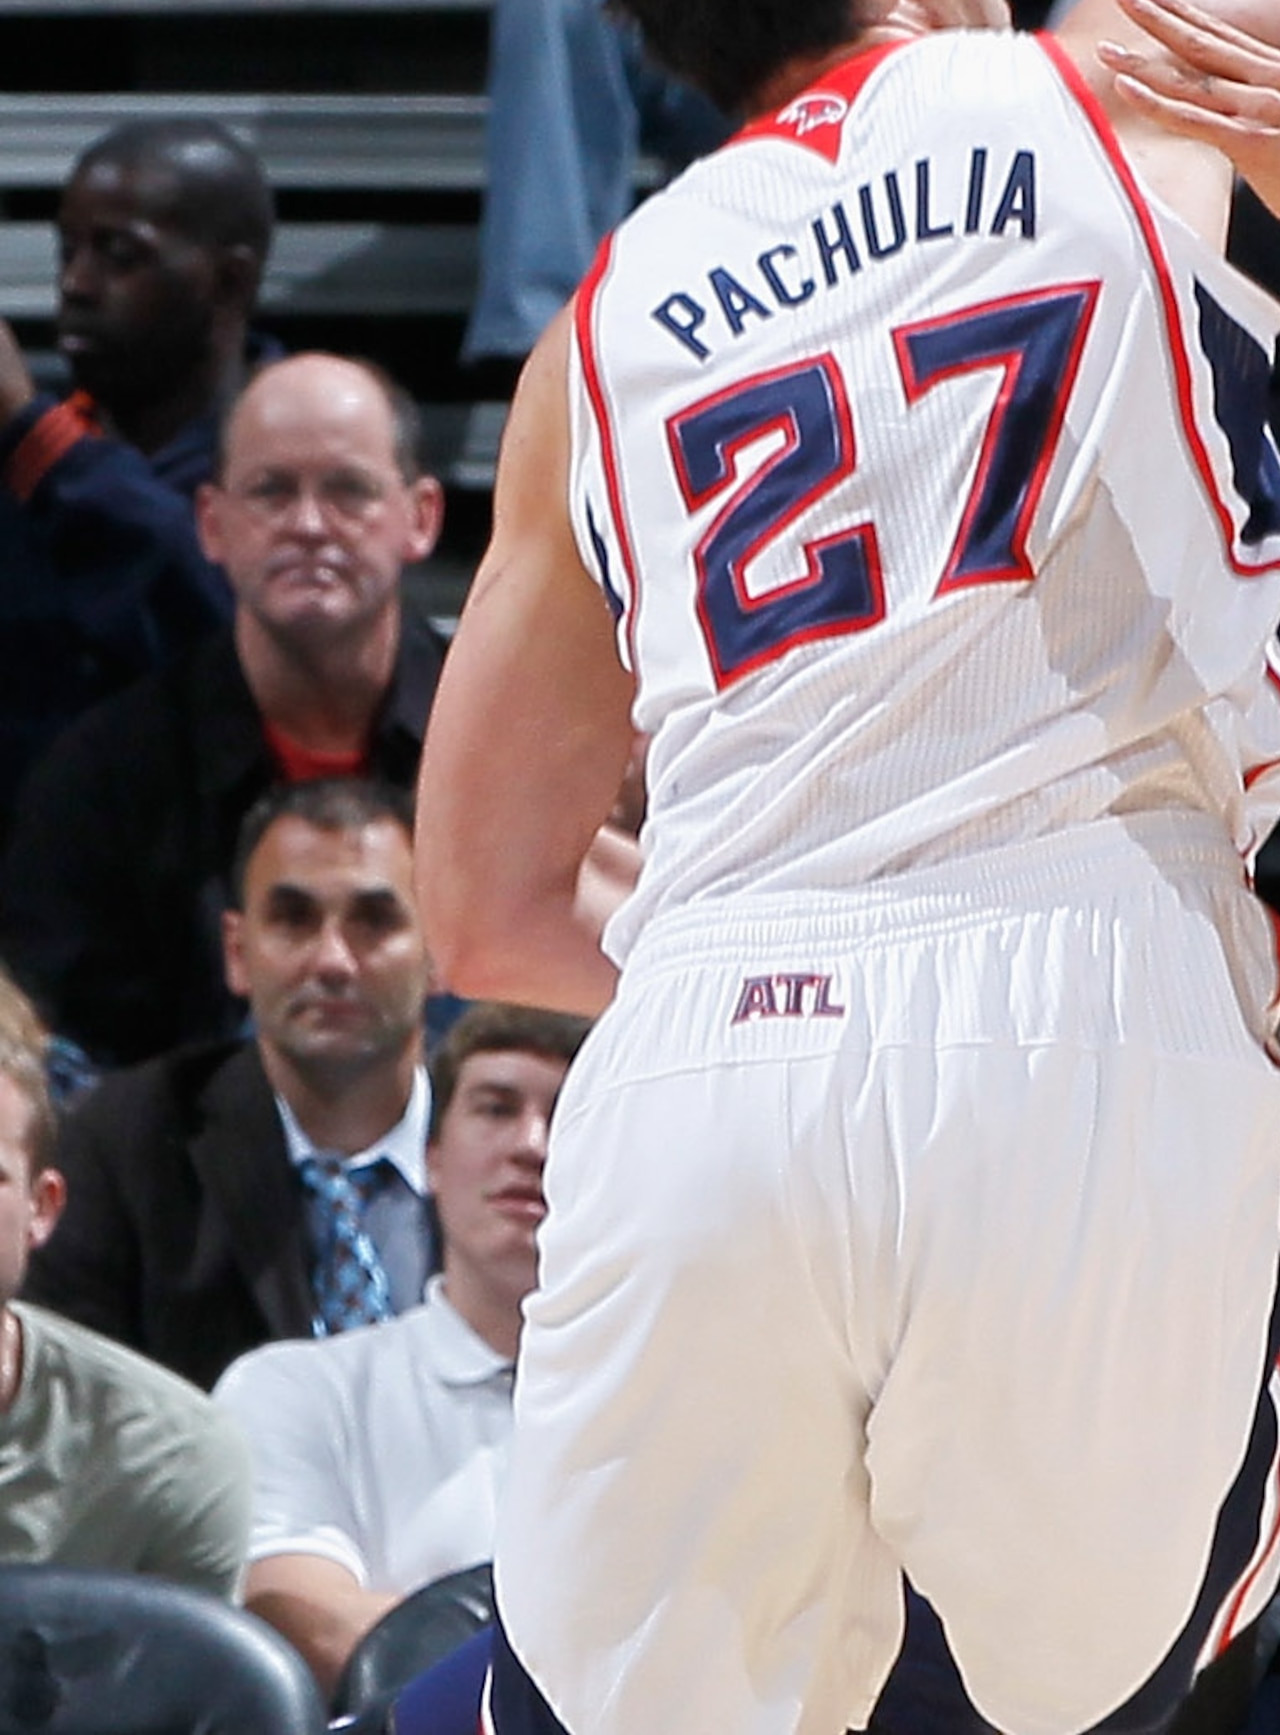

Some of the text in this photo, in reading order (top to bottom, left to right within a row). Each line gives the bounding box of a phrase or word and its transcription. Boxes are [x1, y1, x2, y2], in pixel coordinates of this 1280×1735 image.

[652, 148, 1037, 361] PACHULIA
[666, 280, 1102, 692] 27
[731, 973, 846, 1027] ATL
